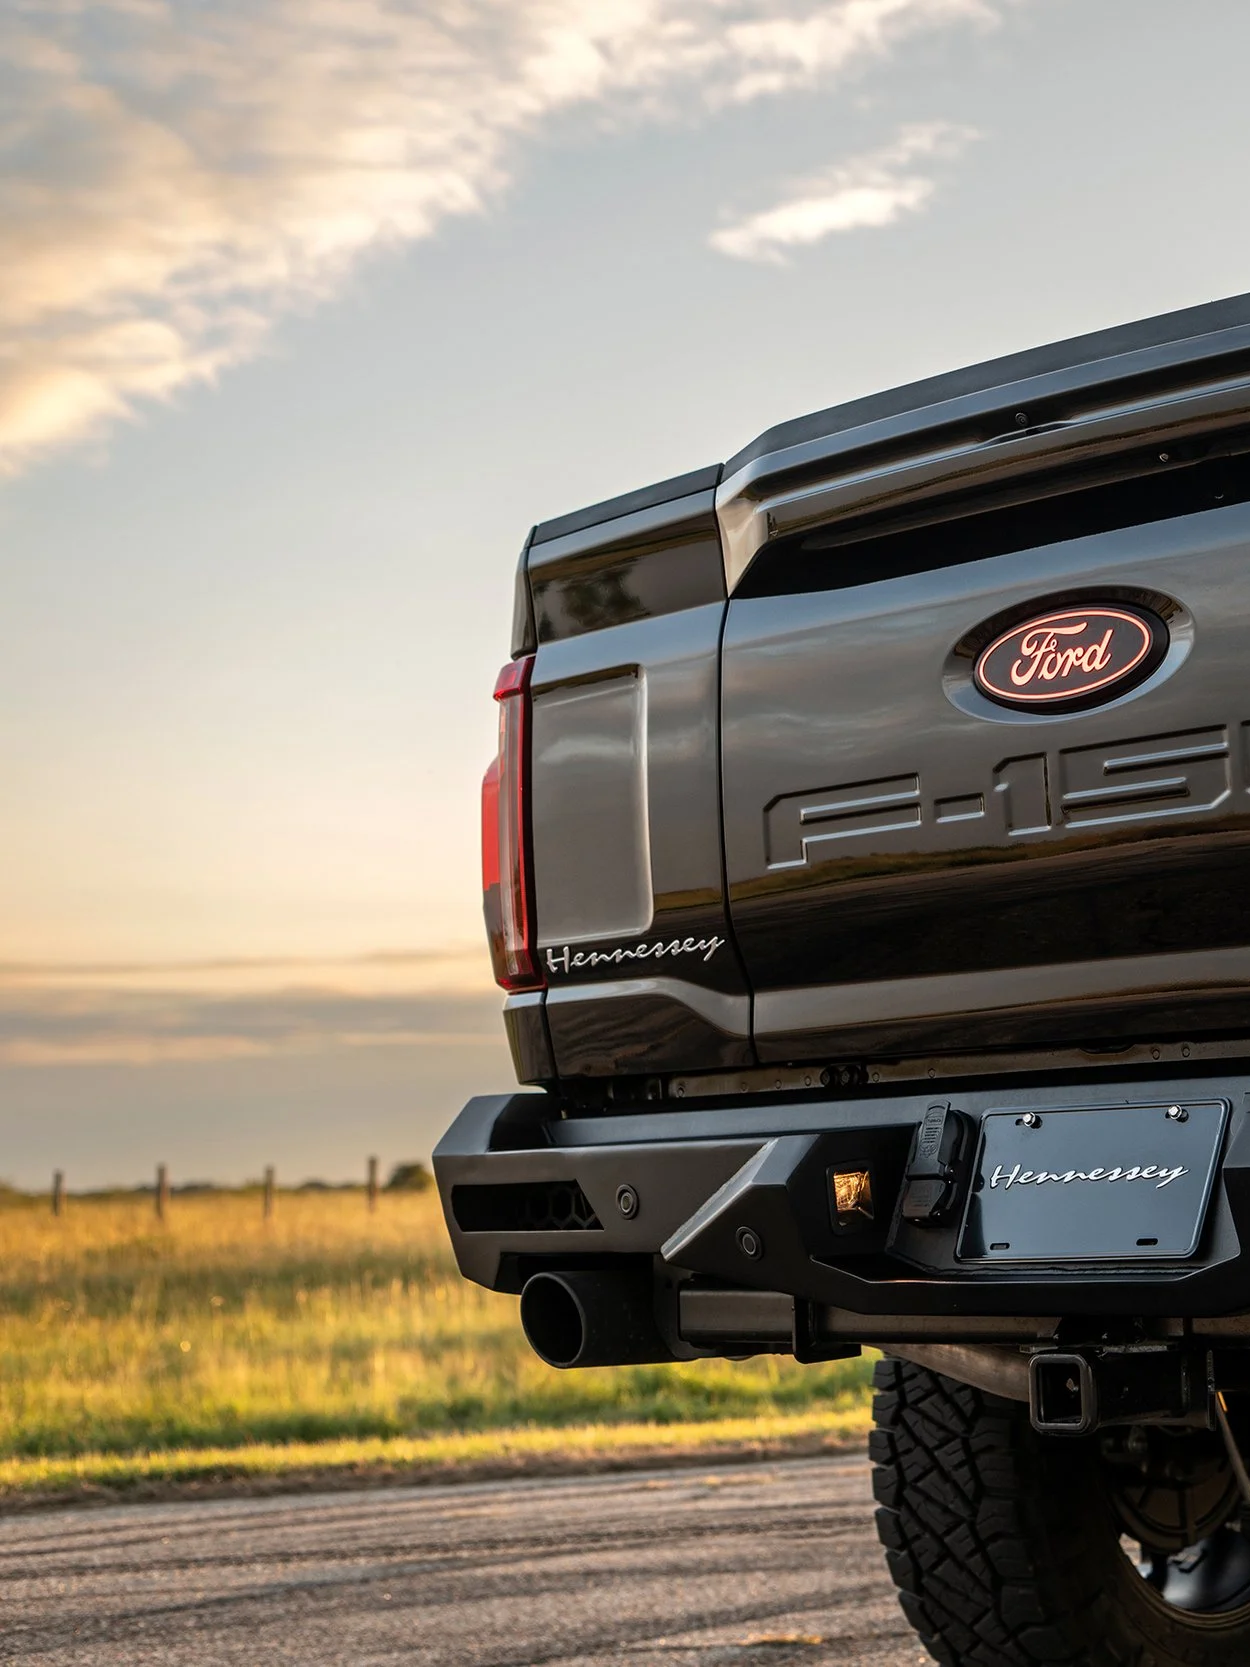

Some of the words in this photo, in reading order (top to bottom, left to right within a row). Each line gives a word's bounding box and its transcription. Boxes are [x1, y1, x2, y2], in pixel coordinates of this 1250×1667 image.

[1011, 622, 1113, 686] Ford
[546, 935, 725, 974] Hennessey
[990, 1163, 1189, 1190] Hennessey
